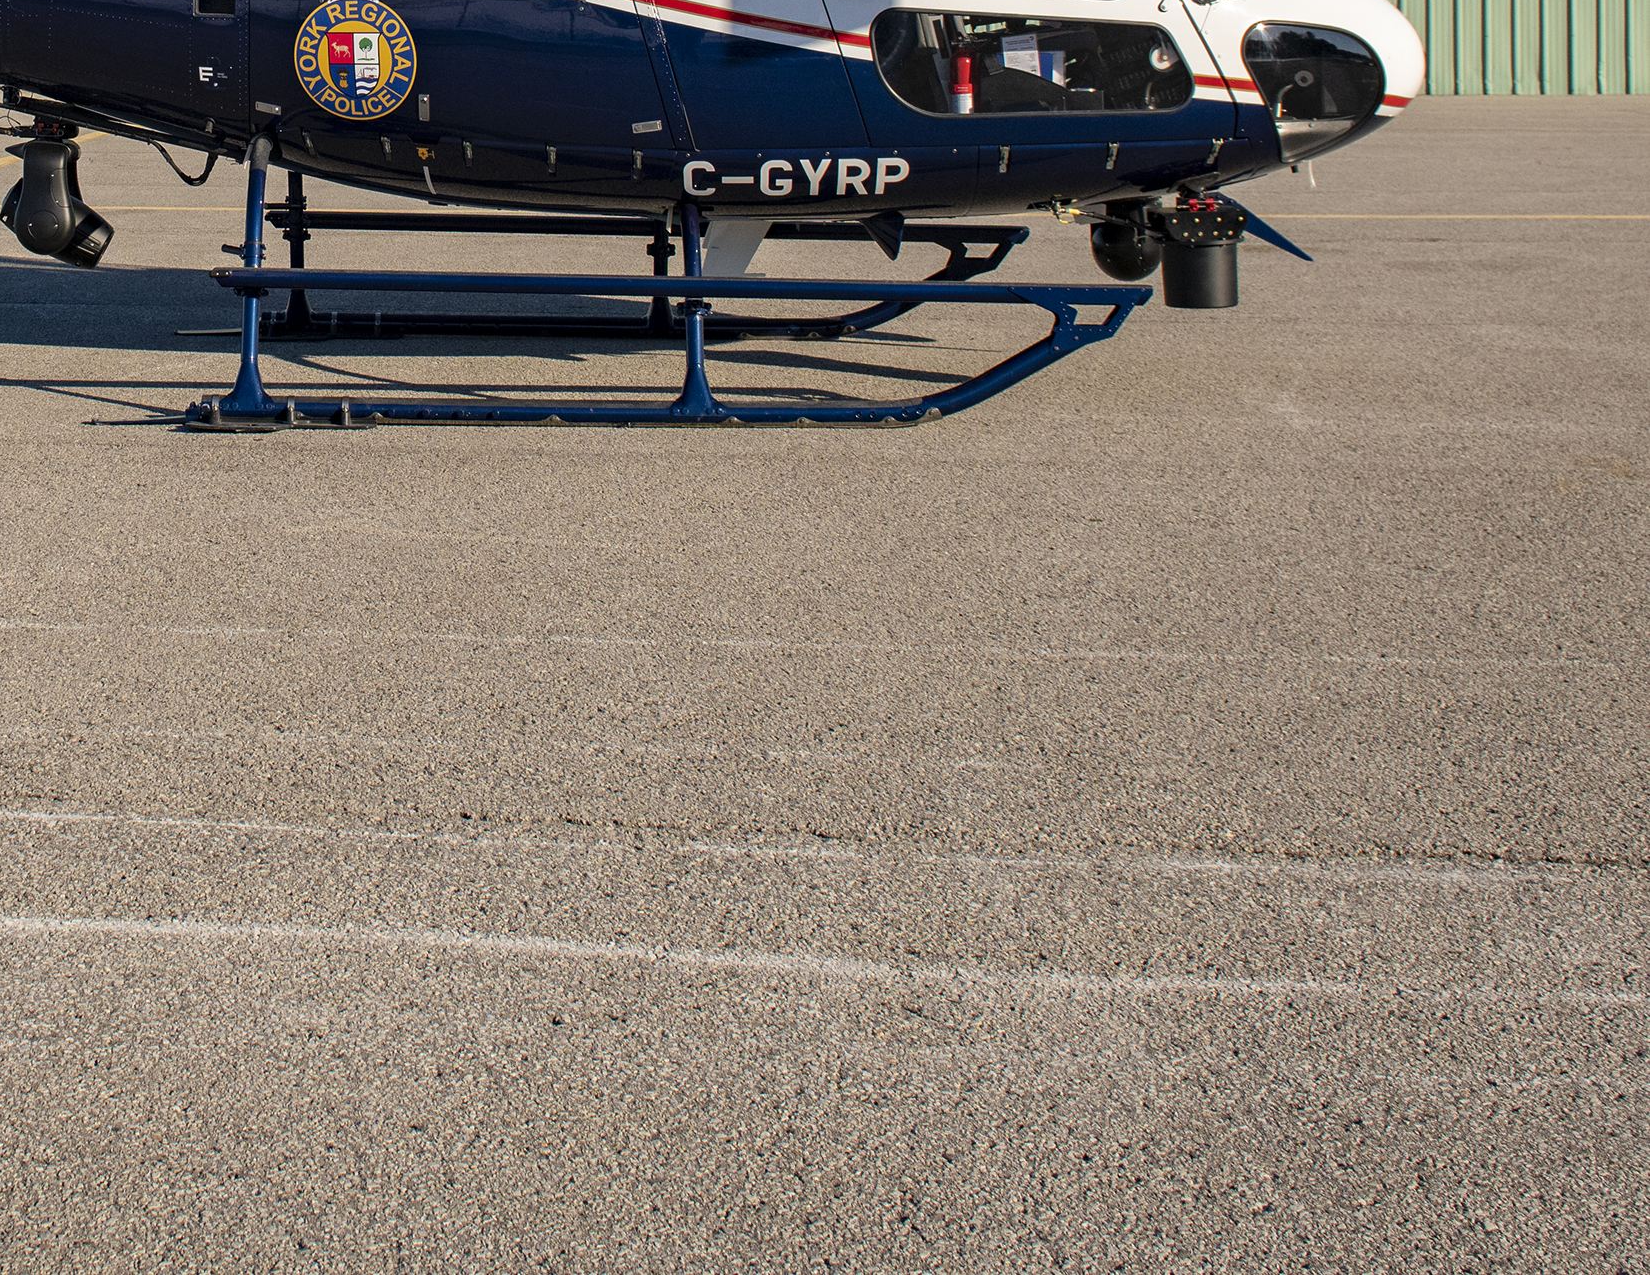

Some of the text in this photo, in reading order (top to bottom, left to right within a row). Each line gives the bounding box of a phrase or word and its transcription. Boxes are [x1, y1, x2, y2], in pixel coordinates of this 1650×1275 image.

[299, 0, 412, 90] YORK REGIONAL
[320, 89, 396, 116] POLICE
[683, 157, 910, 197] C-GYRP
